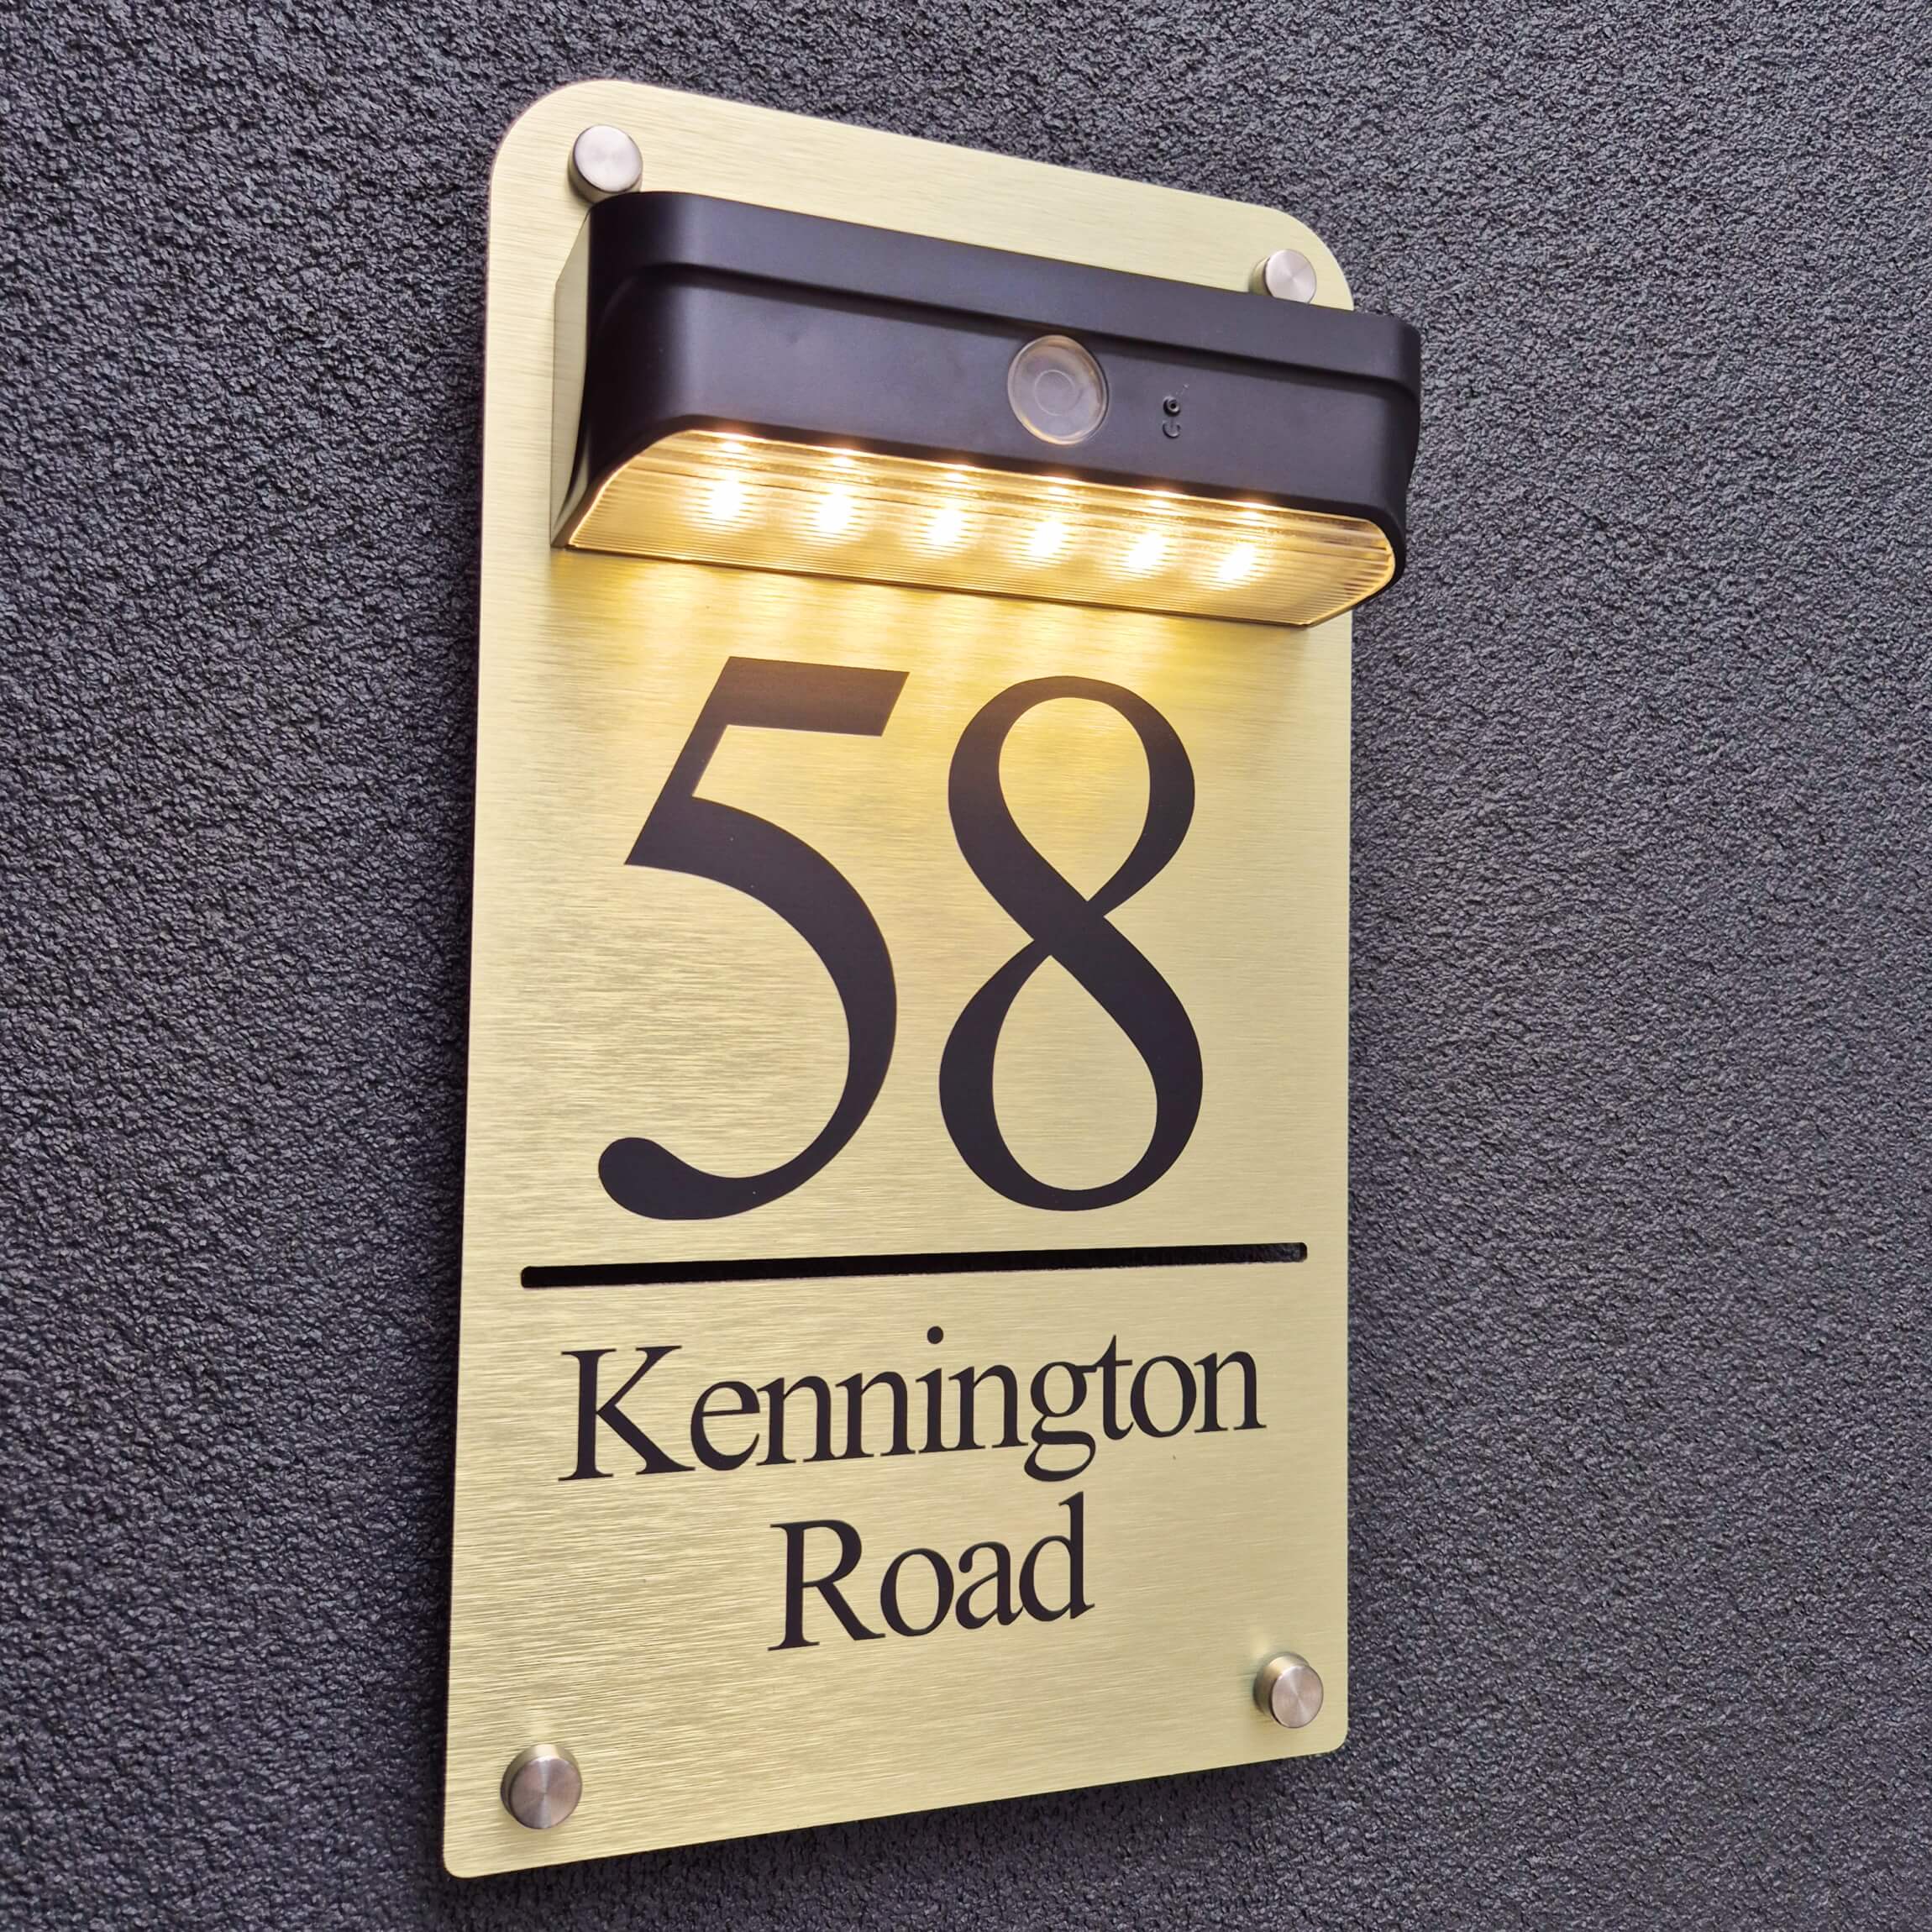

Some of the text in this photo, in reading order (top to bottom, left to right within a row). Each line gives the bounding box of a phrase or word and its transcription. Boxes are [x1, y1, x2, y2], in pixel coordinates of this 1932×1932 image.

[598, 655, 1204, 1221] 58
[559, 1325, 1267, 1483] Kennington
[768, 1491, 1095, 1651] Road
